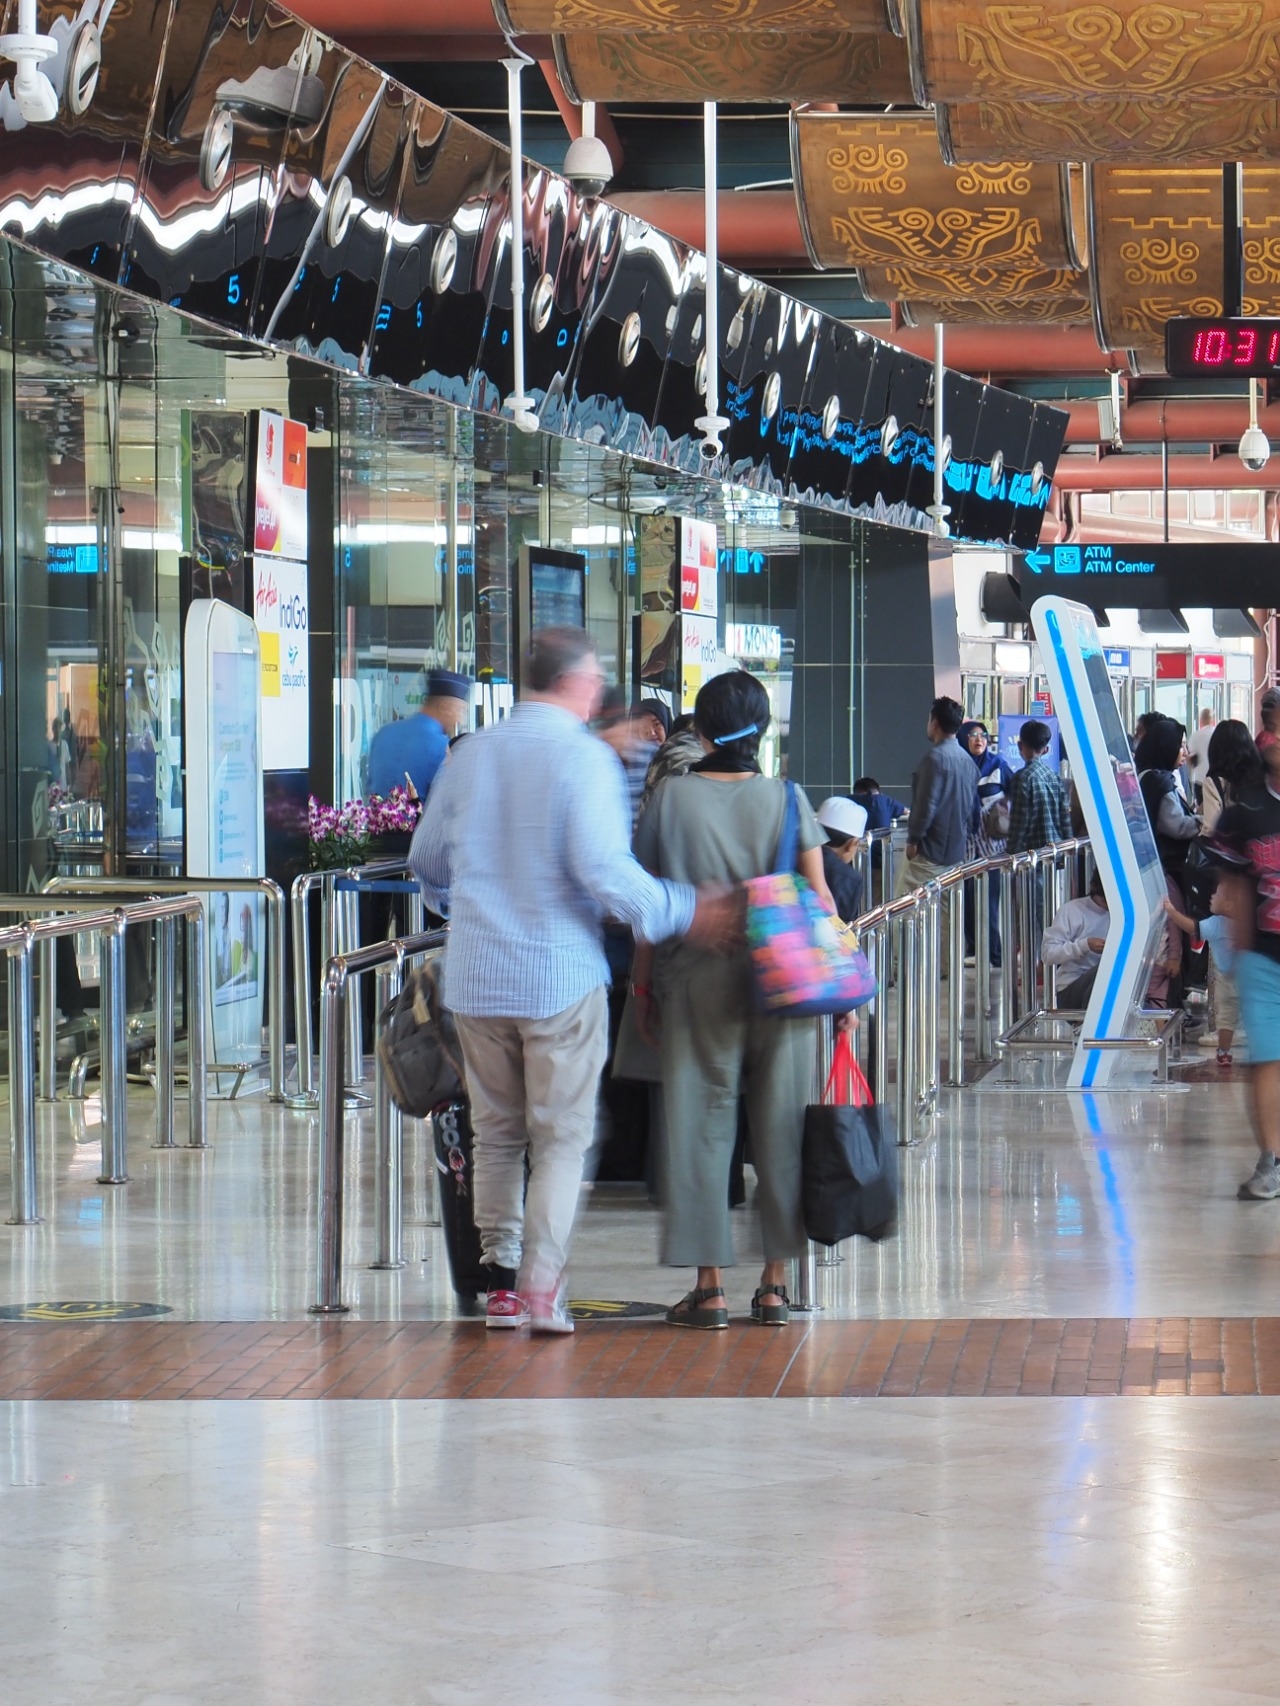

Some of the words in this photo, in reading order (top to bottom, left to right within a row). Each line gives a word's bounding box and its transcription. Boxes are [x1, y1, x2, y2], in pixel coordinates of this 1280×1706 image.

[1194, 330, 1278, 363] 10:31
[1083, 546, 1112, 558] ATM
[1084, 560, 1113, 573] ATM
[1115, 560, 1156, 573] Center
[279, 593, 307, 630] IndiGo
